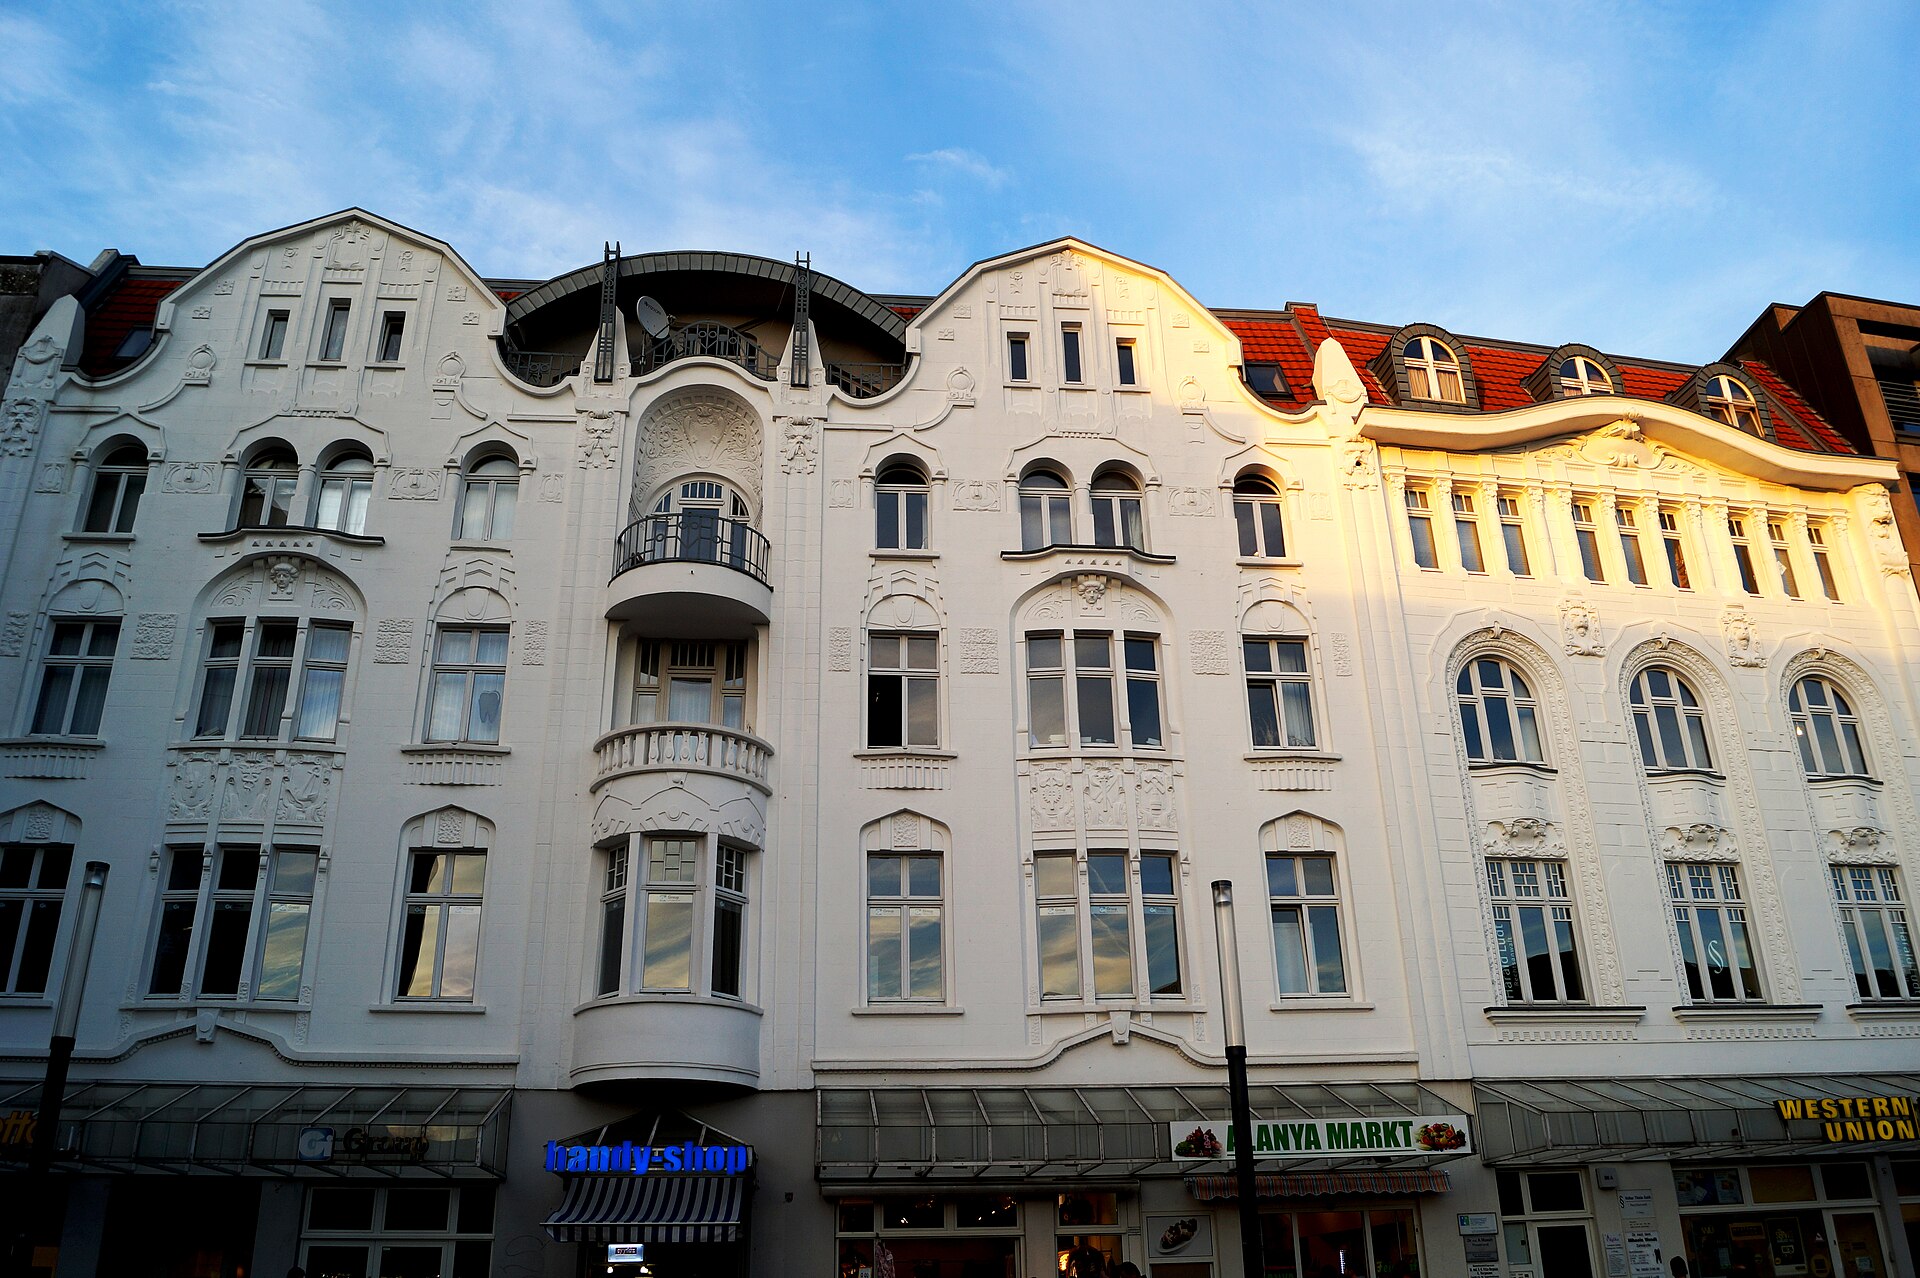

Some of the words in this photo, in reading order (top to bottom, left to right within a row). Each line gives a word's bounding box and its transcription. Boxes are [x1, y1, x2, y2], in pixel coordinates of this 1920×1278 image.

[1898, 926, 1916, 966] Harald
[1502, 957, 1514, 999] Harald
[1778, 1096, 1910, 1120] WESTERN
[343, 1127, 429, 1162] Group
[1326, 1120, 1413, 1150] MARKT
[1825, 1119, 1915, 1142] UNION
[545, 1140, 748, 1176] handy-shop
